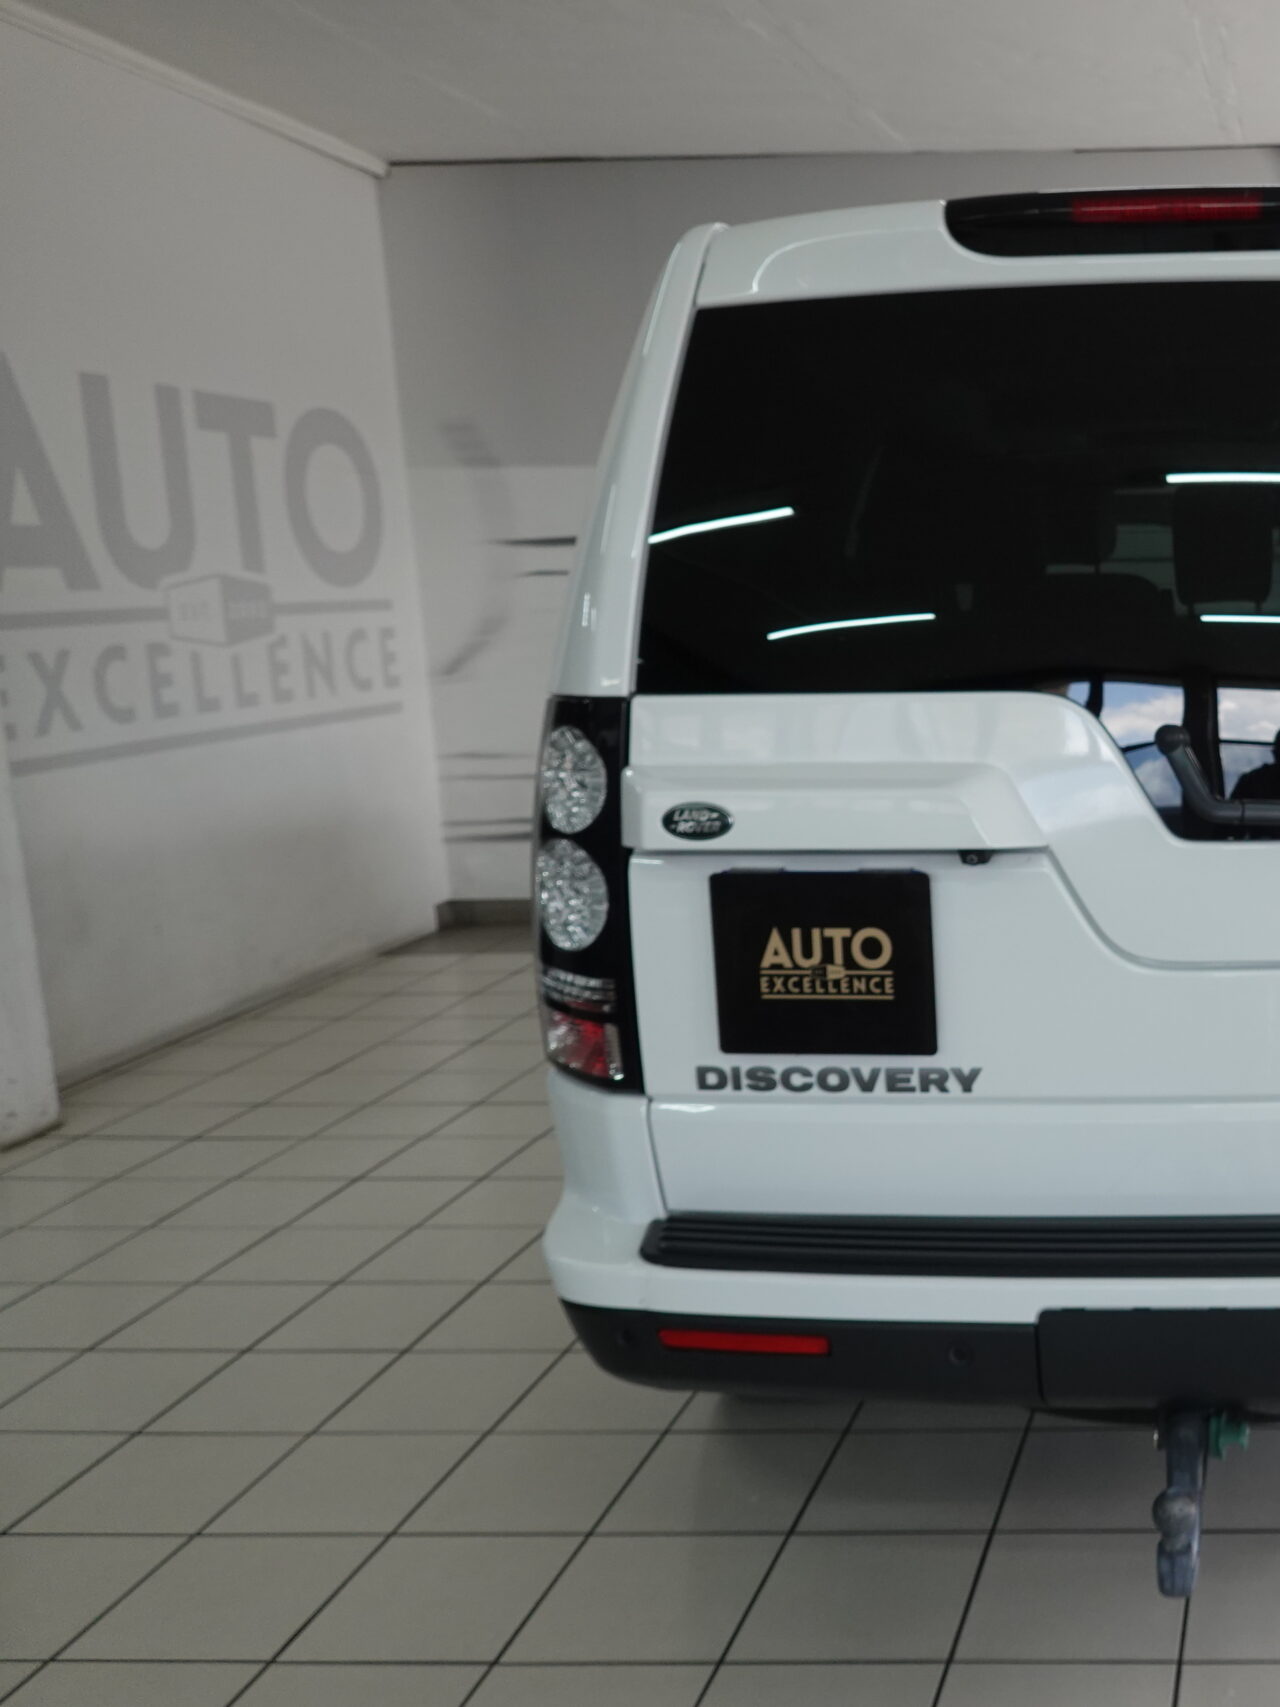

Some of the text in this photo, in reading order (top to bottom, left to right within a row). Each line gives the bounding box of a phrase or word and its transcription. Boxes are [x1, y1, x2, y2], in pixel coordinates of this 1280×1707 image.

[0, 350, 382, 590] AUTO
[760, 926, 893, 969] AUTO
[760, 976, 895, 994] EXCELLENCE
[695, 1065, 983, 1093] DISCOVERY
